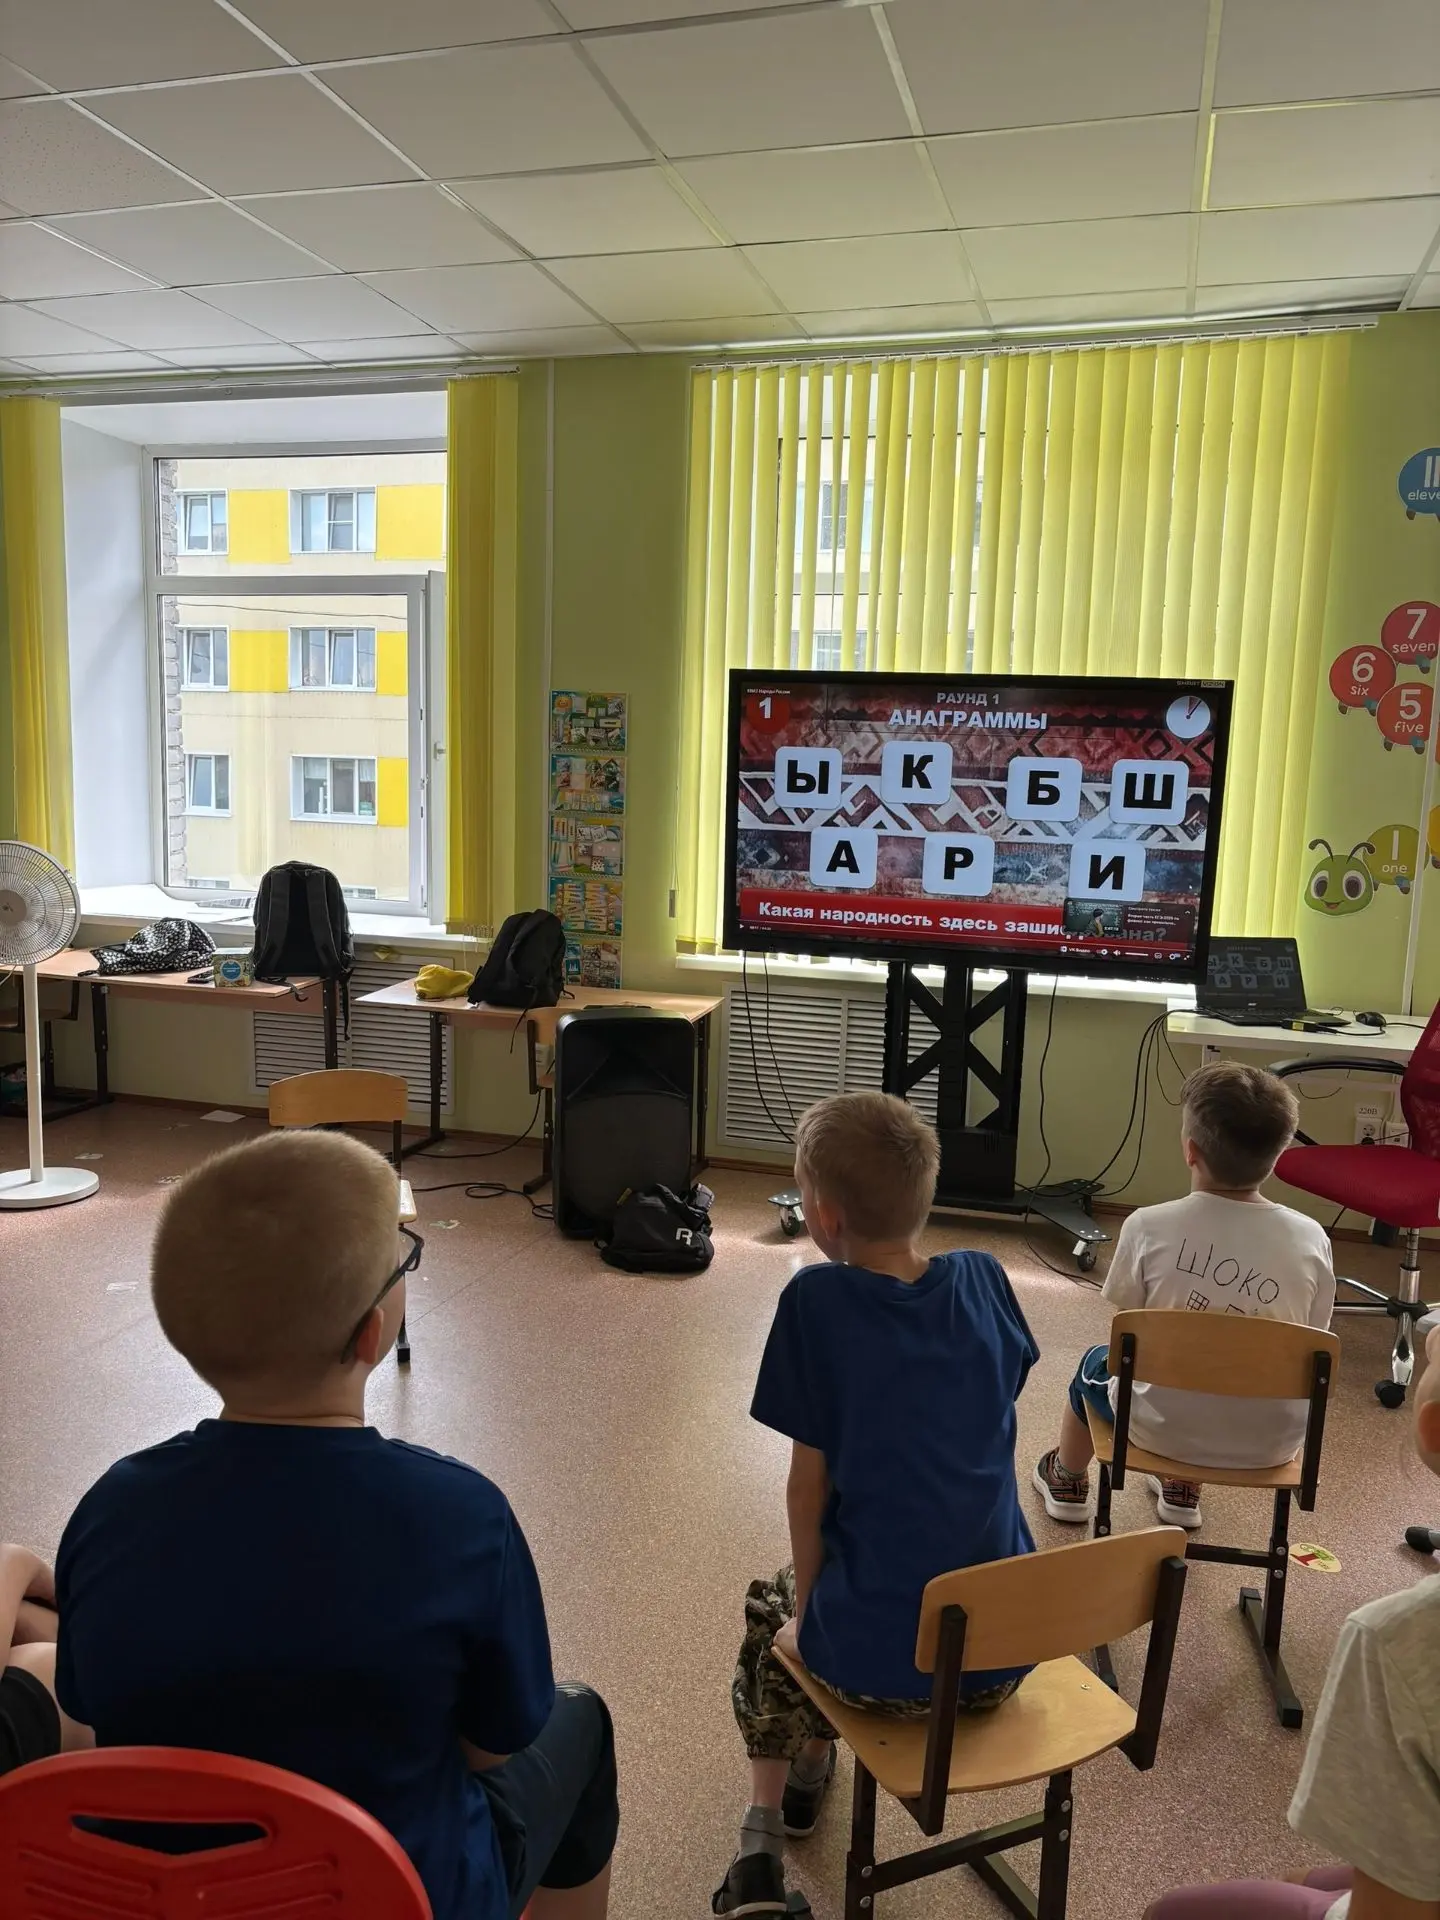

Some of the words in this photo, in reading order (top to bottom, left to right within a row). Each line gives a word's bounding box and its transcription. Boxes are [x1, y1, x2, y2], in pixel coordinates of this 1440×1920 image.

[1408, 489, 1440, 501] eleve
[1406, 608, 1428, 640] 7
[1392, 641, 1436, 654] seven
[1352, 651, 1377, 683] 6
[937, 692, 988, 706] РАУНД
[991, 693, 1000, 705] 1
[1350, 684, 1369, 696] six
[759, 697, 772, 719] 1
[1399, 688, 1422, 720] 5
[888, 709, 1048, 731] АНАГРАММЫ
[1394, 721, 1424, 733] five
[786, 759, 830, 795] Ы
[901, 754, 934, 790] К
[1027, 770, 1061, 806] Б
[1123, 773, 1175, 810] Ш
[1391, 830, 1400, 861] 1
[826, 840, 861, 874] А
[943, 847, 974, 881] Р
[1088, 854, 1126, 890] И
[1382, 864, 1408, 874] one
[759, 902, 814, 919] Какая
[820, 909, 933, 927] народность
[939, 916, 999, 931] здесь
[1176, 1238, 1280, 1305] ШОКО
